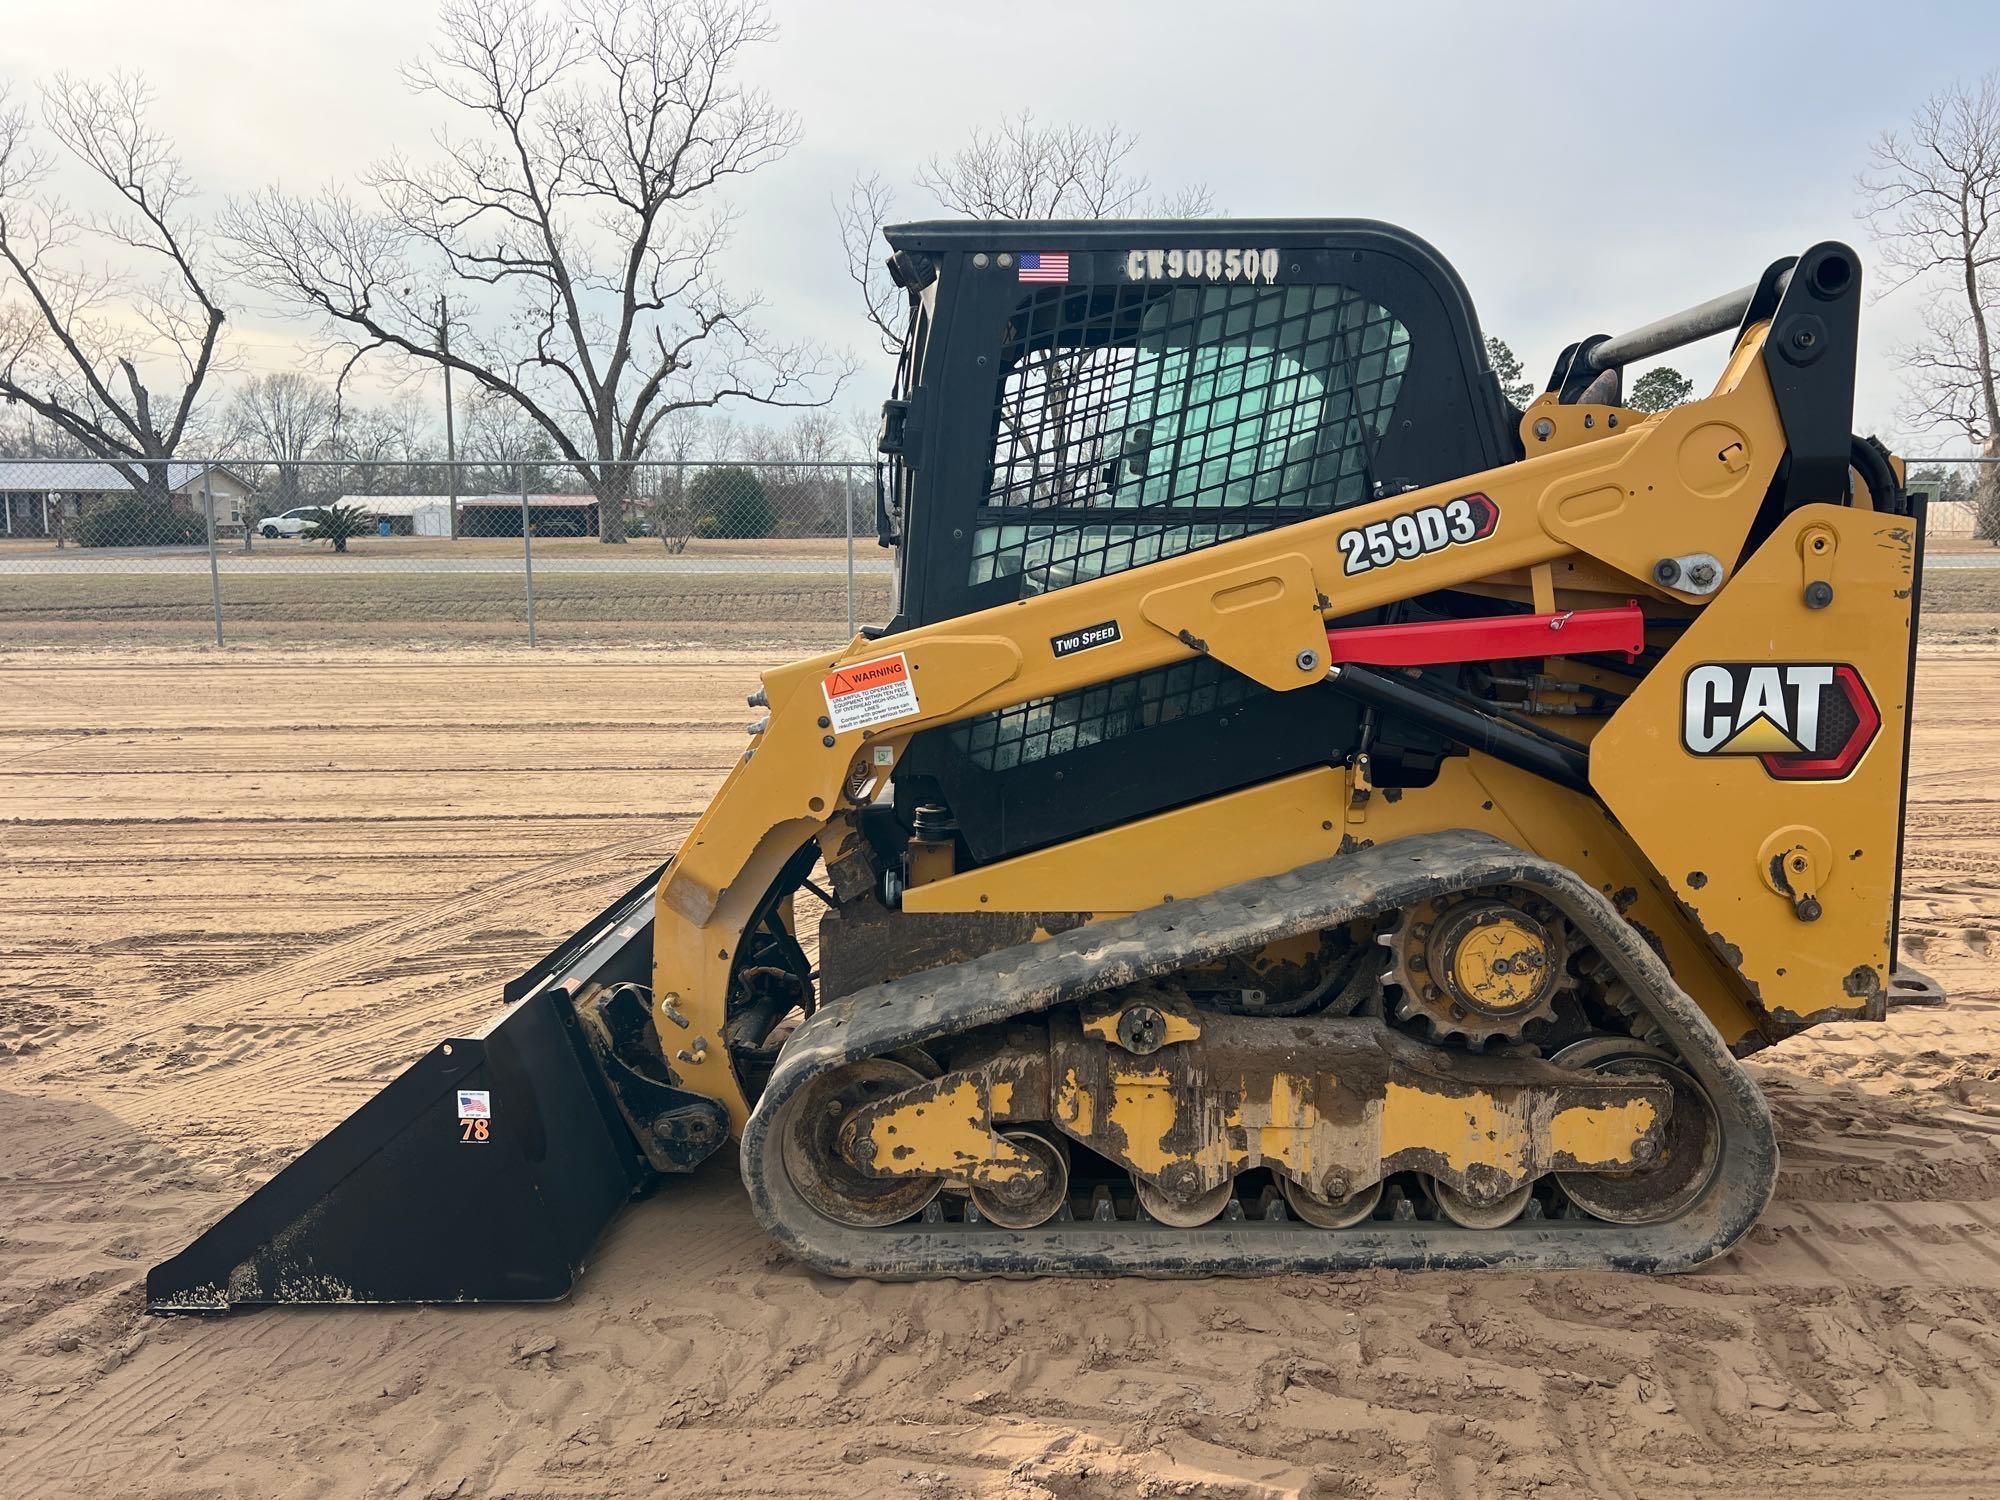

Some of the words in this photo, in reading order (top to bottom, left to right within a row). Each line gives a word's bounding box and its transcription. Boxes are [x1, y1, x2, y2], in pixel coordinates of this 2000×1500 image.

[1127, 249, 1279, 284] CW908500
[1338, 499, 1476, 573] 259D3
[852, 663, 902, 683] WARNING
[833, 693, 861, 704] UNLAWFUL
[870, 685, 894, 695] OPERATE
[834, 697, 864, 709] EQUIPMENT
[864, 693, 883, 701] WITHIN
[843, 701, 872, 712] OVERHEAD
[872, 691, 910, 705] HIGH-VOLTAGE
[840, 714, 860, 723] Contact
[872, 708, 887, 716] power
[859, 716, 873, 725] death
[880, 710, 897, 719] serious
[1685, 665, 1833, 753] CAT
[460, 1119, 489, 1140] 78
